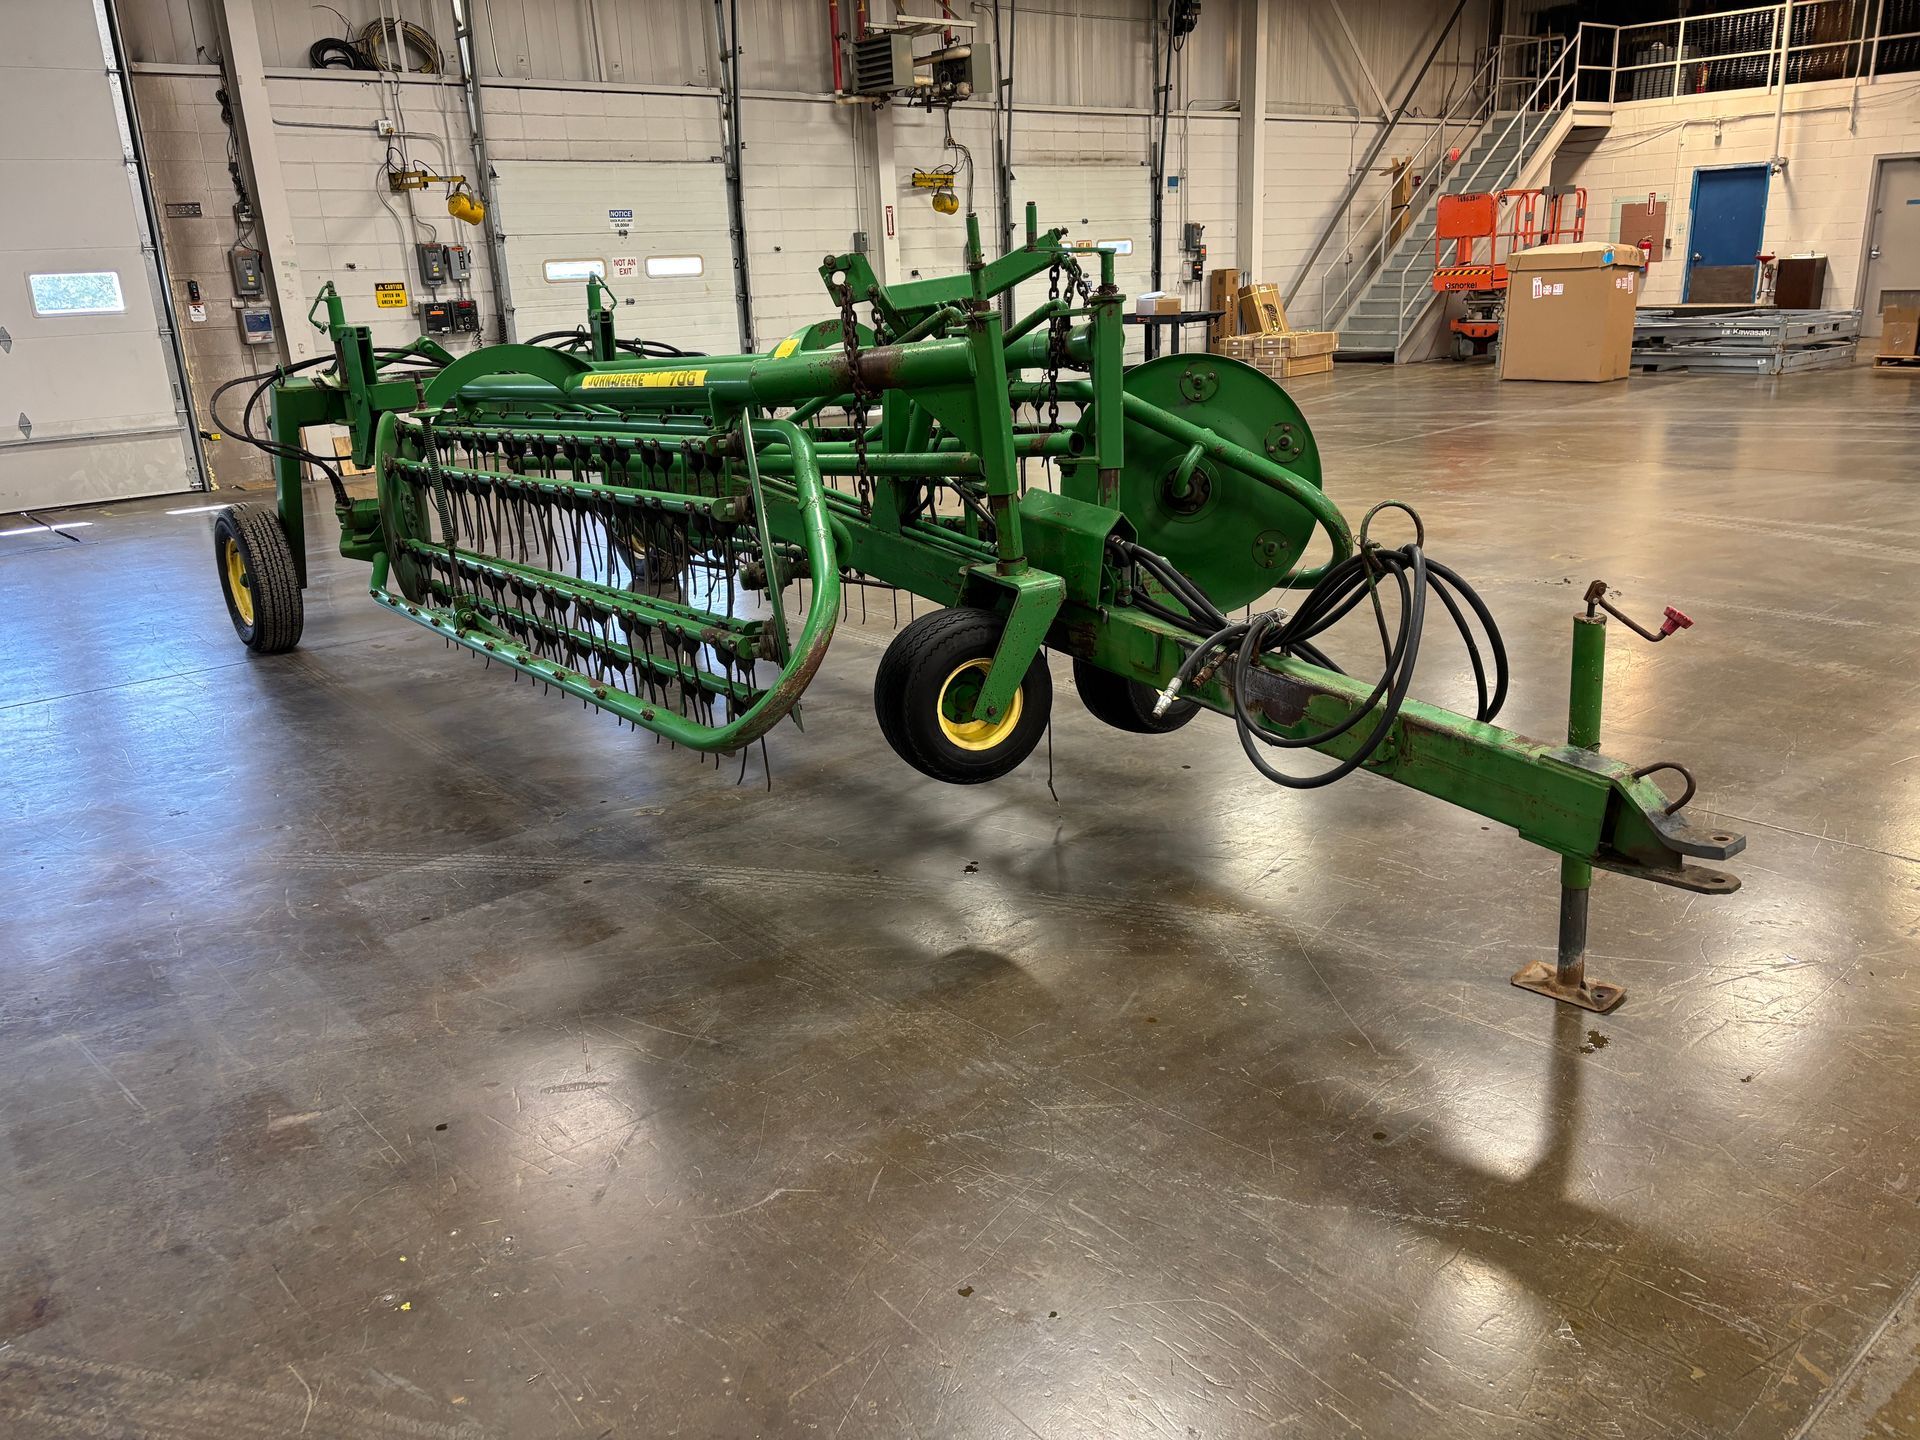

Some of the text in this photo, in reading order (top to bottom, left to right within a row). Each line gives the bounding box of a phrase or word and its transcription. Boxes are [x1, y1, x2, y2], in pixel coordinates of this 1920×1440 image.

[613, 258, 636, 267] NOT AN
[733, 257, 740, 269] 2
[619, 267, 632, 275] EXIT
[1449, 281, 1477, 289] snorkel
[1732, 328, 1771, 336] Kawasaki
[588, 375, 612, 387] JOHN
[613, 374, 645, 387] DEERE
